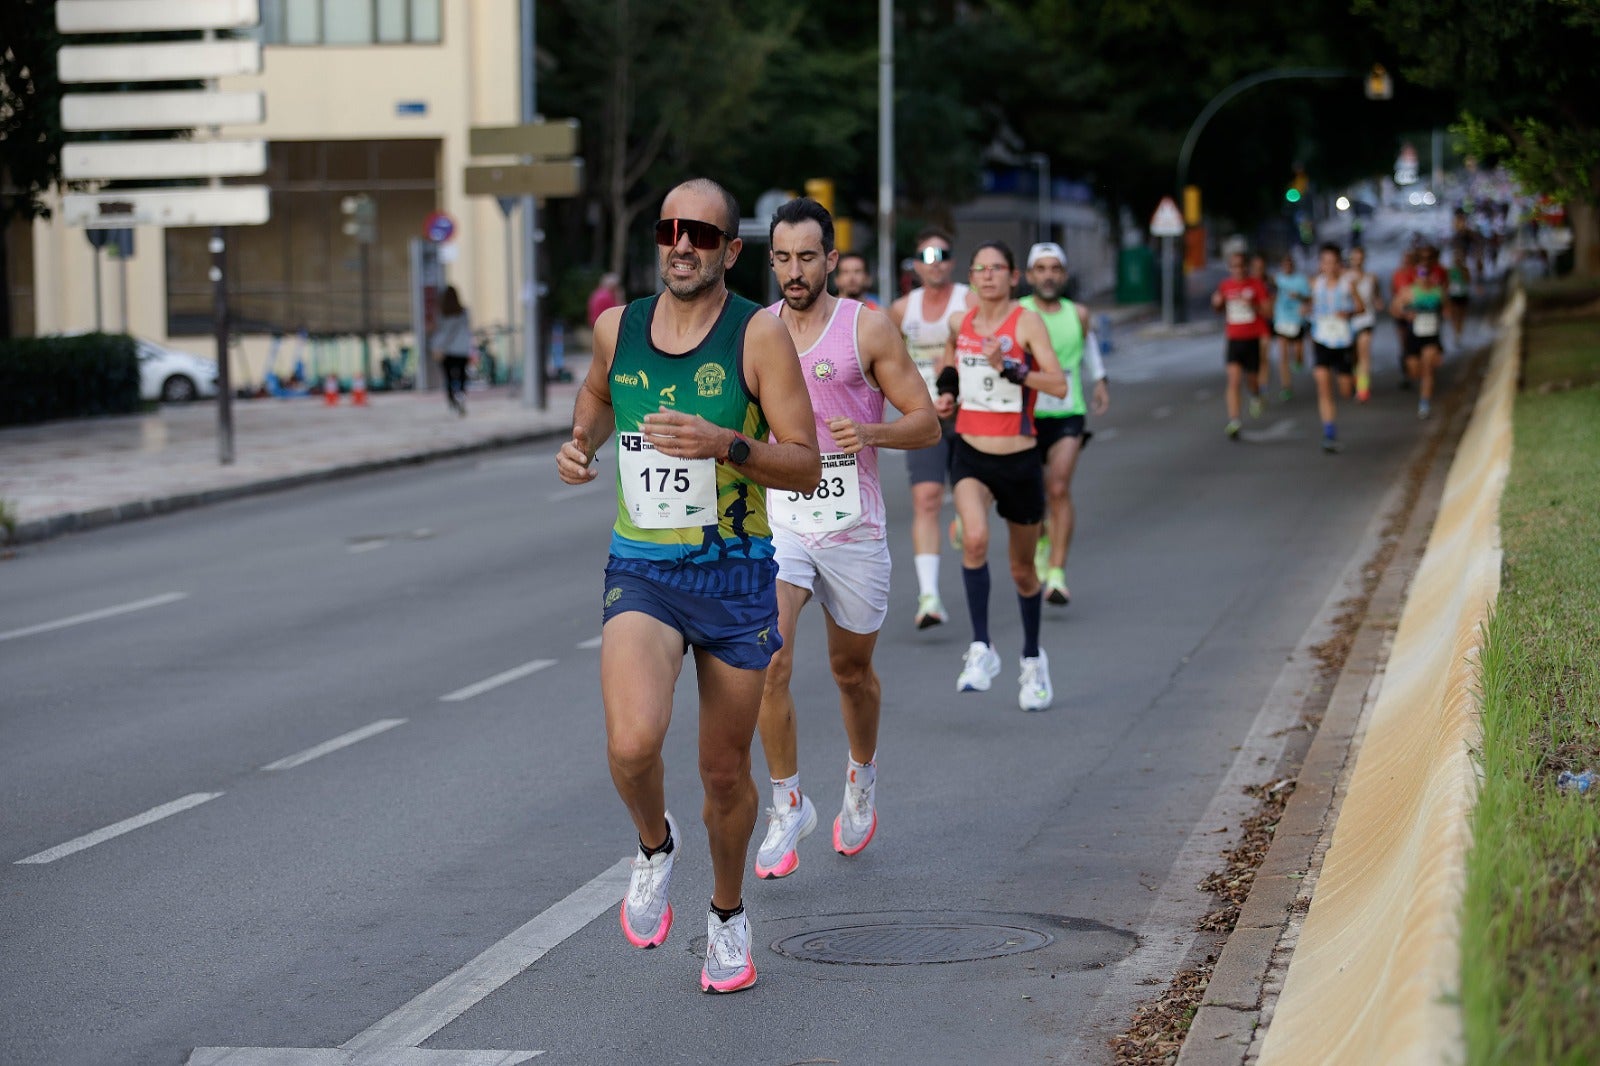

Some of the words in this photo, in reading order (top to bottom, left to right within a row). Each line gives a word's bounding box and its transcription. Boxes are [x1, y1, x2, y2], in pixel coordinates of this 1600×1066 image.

[983, 377, 994, 391] 9
[621, 435, 642, 451] 43
[640, 468, 690, 492] 175
